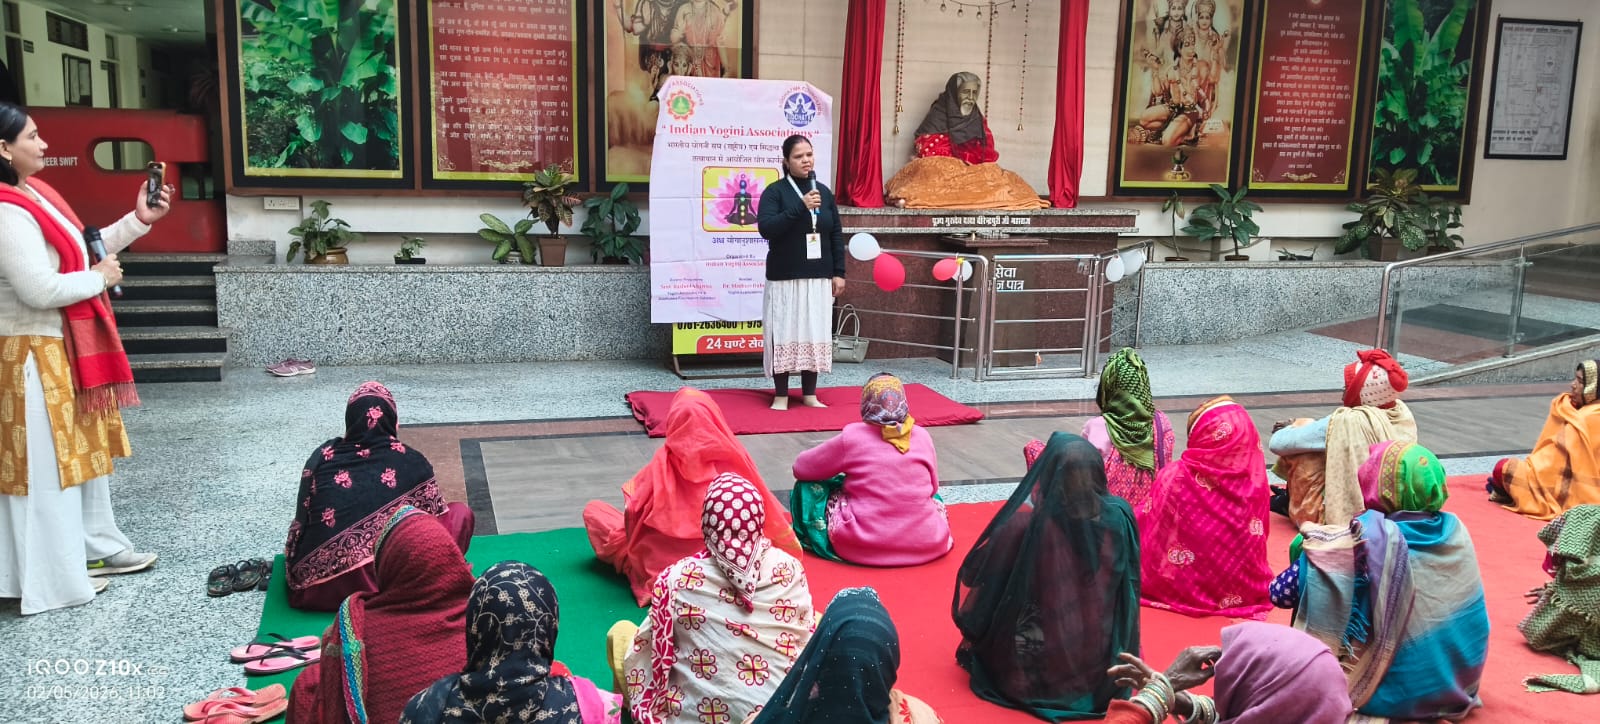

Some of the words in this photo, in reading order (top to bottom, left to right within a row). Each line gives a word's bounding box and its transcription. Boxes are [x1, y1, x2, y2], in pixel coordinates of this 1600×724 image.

[670, 124, 707, 136] Indian
[709, 126, 745, 139] Yogini
[59, 156, 78, 167] SWIFT
[706, 337, 722, 350] 24
[748, 336, 764, 348] सेव
